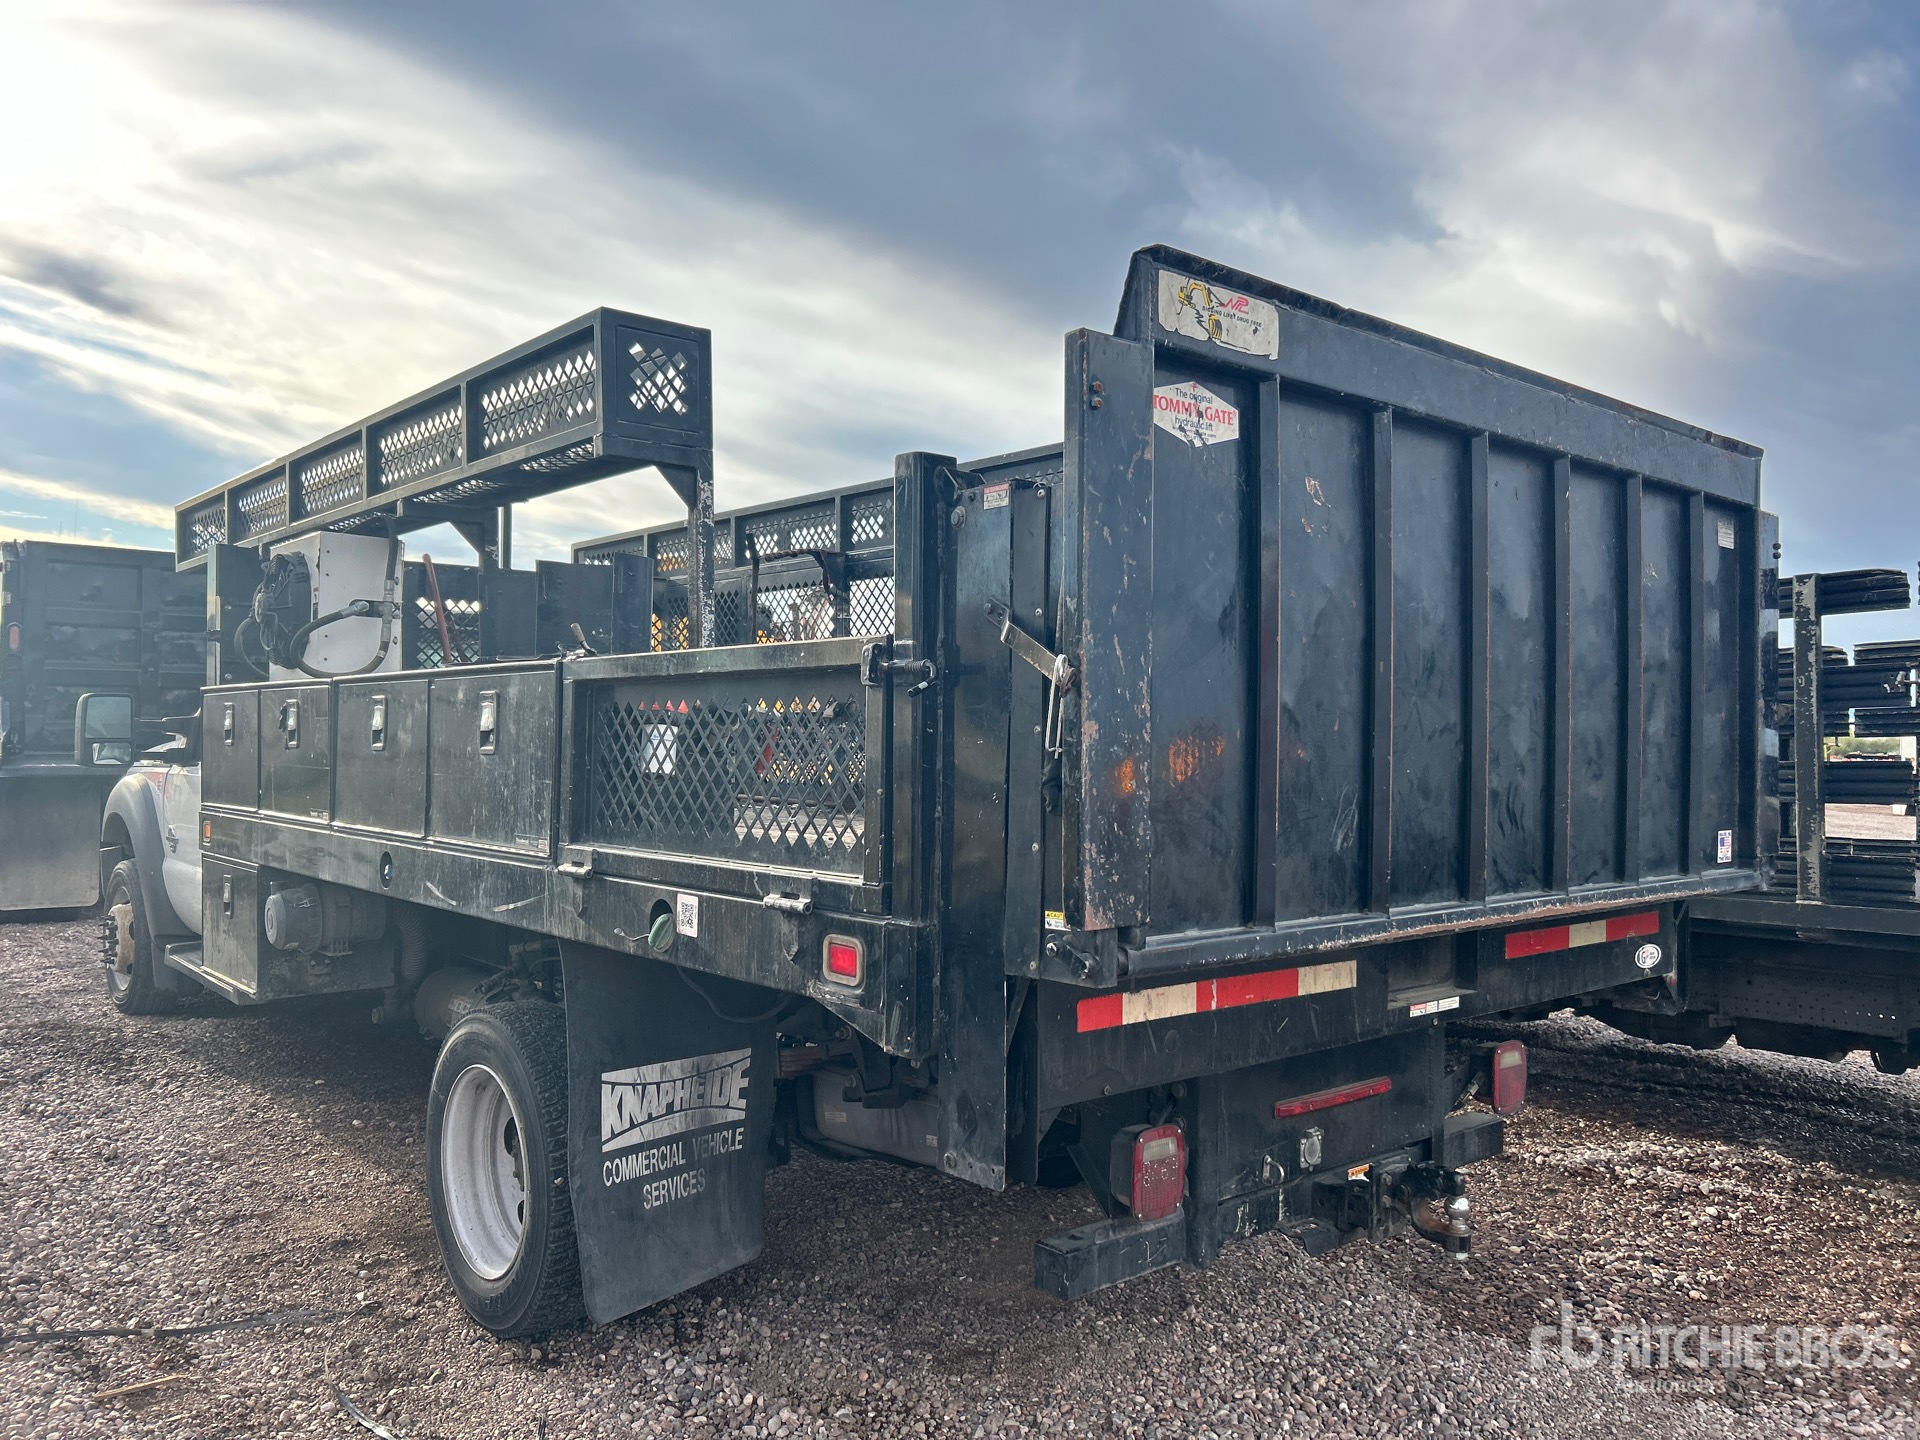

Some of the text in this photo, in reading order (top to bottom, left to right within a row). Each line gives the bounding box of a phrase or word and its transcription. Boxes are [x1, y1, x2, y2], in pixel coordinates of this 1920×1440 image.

[1154, 394, 1233, 426] TOMMY GATE
[1175, 387, 1188, 400] The
[601, 1056, 751, 1142] KNAPHEIDE
[602, 1127, 745, 1187] COMMERCIAL VEHICLE
[643, 1168, 706, 1210] SERVICES
